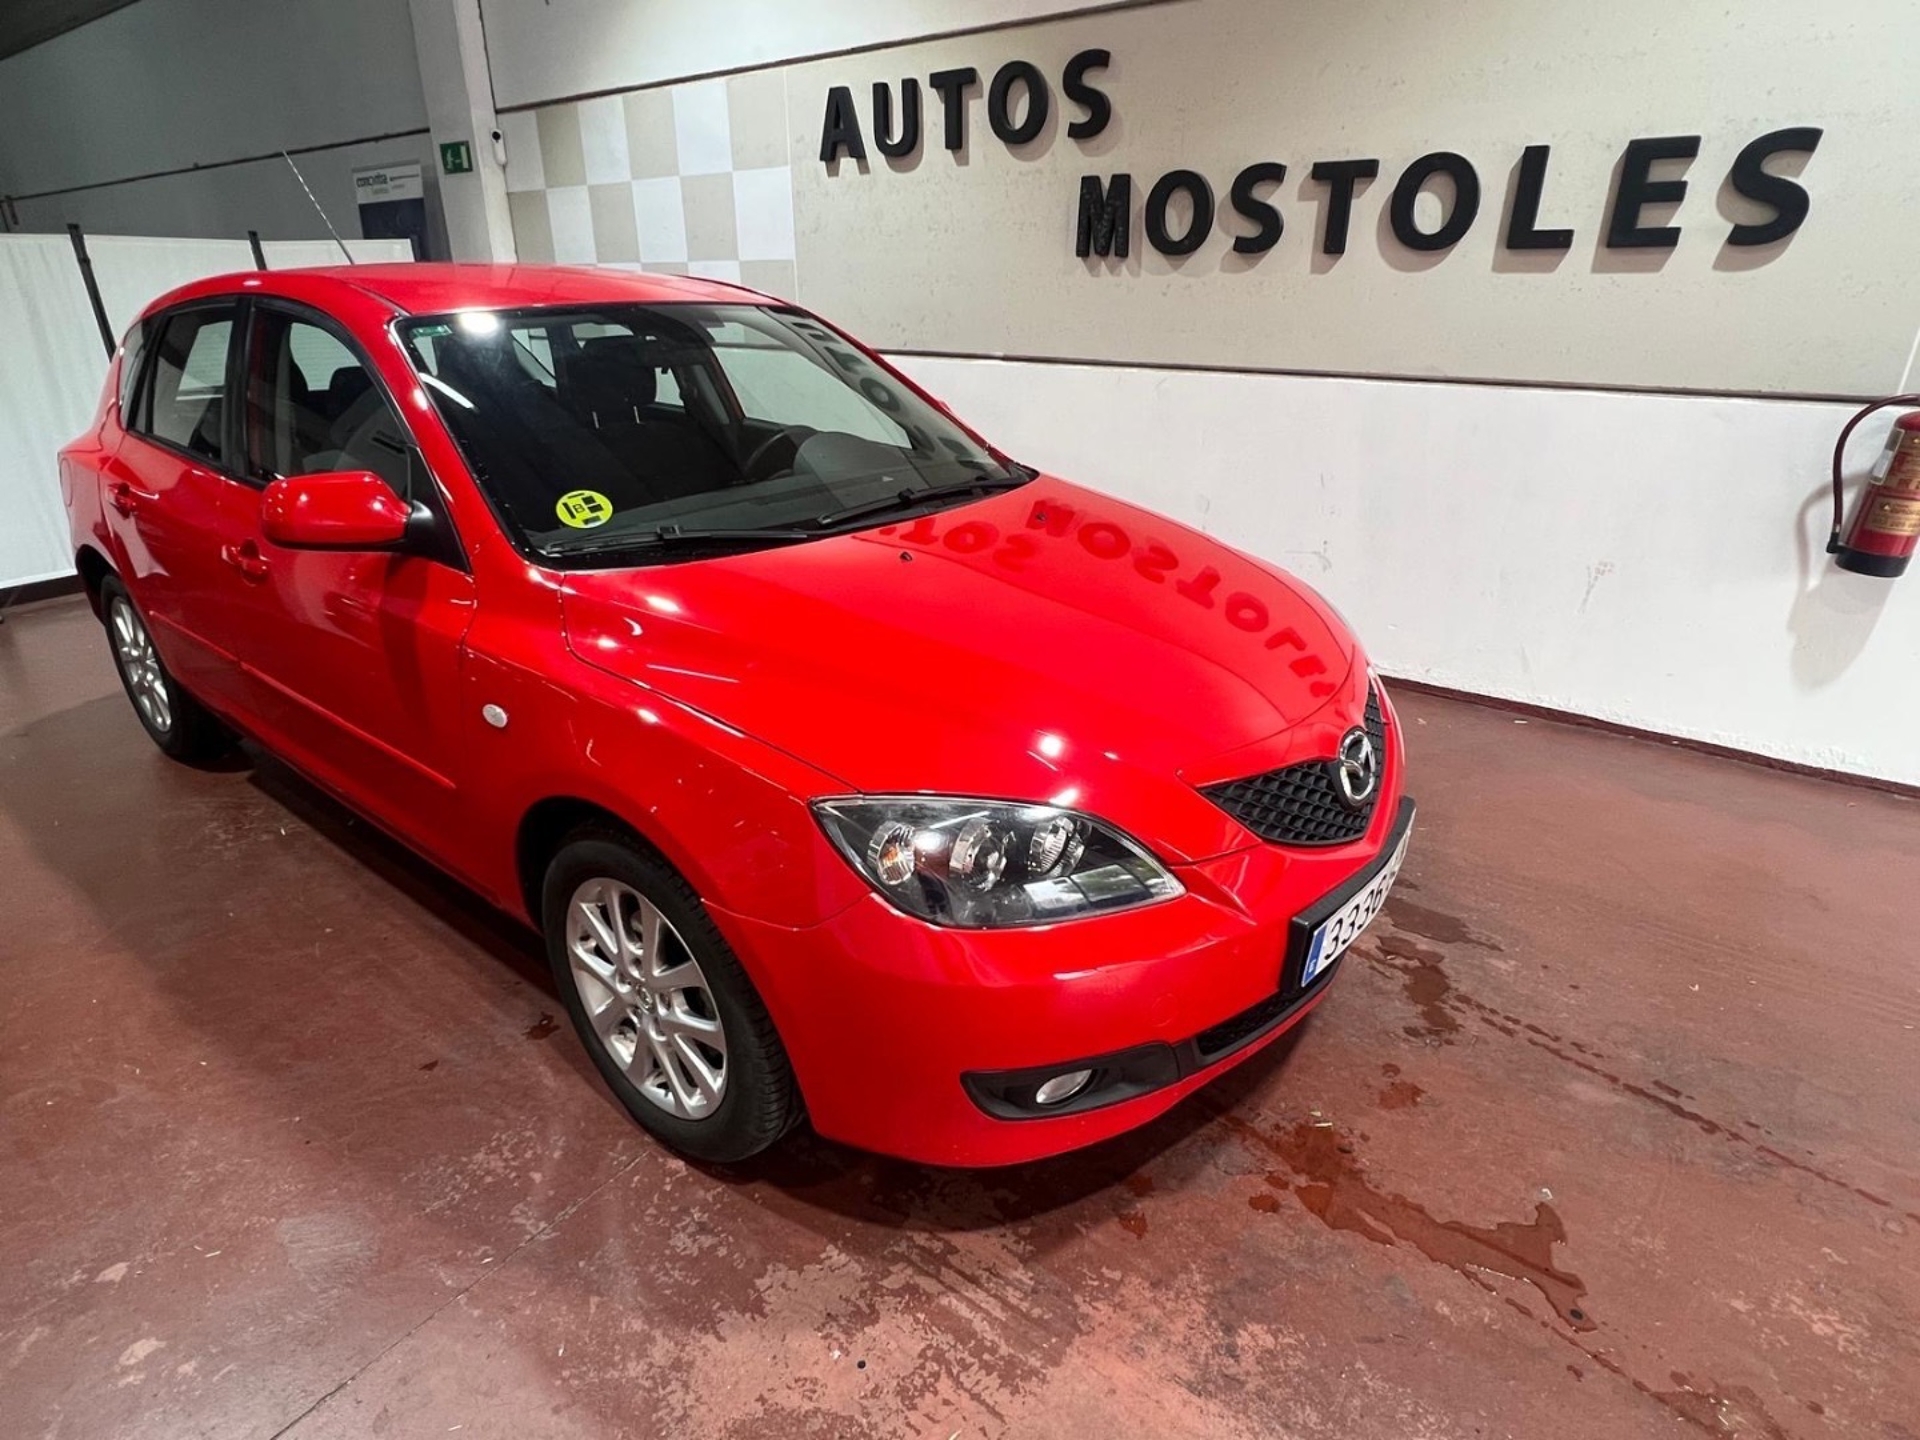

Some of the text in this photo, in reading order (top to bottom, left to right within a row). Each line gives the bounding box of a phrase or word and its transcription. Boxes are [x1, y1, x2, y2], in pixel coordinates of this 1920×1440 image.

[818, 48, 1112, 171] AUTOS
[1075, 127, 1824, 262] MOSTOLES
[1324, 874, 1388, 961] 3336
